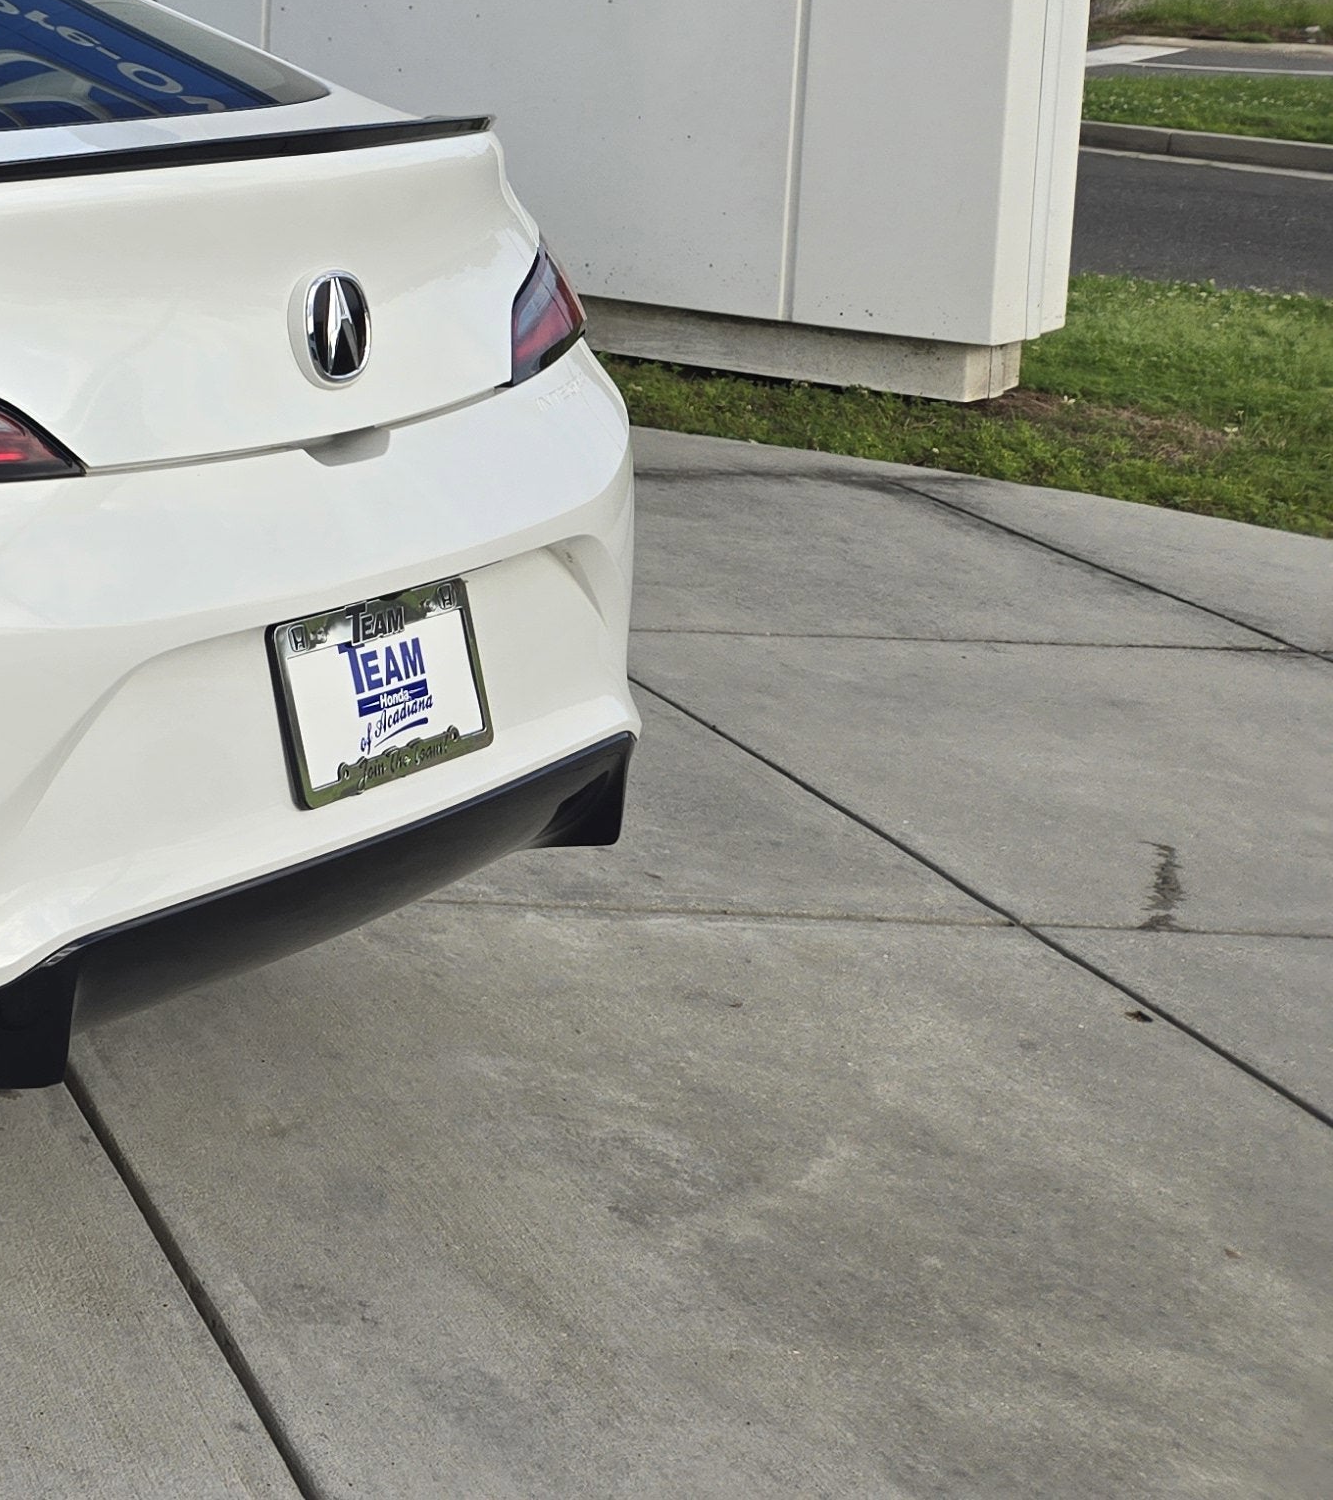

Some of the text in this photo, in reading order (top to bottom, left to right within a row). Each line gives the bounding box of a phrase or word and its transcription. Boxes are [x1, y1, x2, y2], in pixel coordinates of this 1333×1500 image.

[379, 688, 411, 709] Honda
[360, 694, 434, 755] of Acadiana
[357, 757, 385, 790] Join
